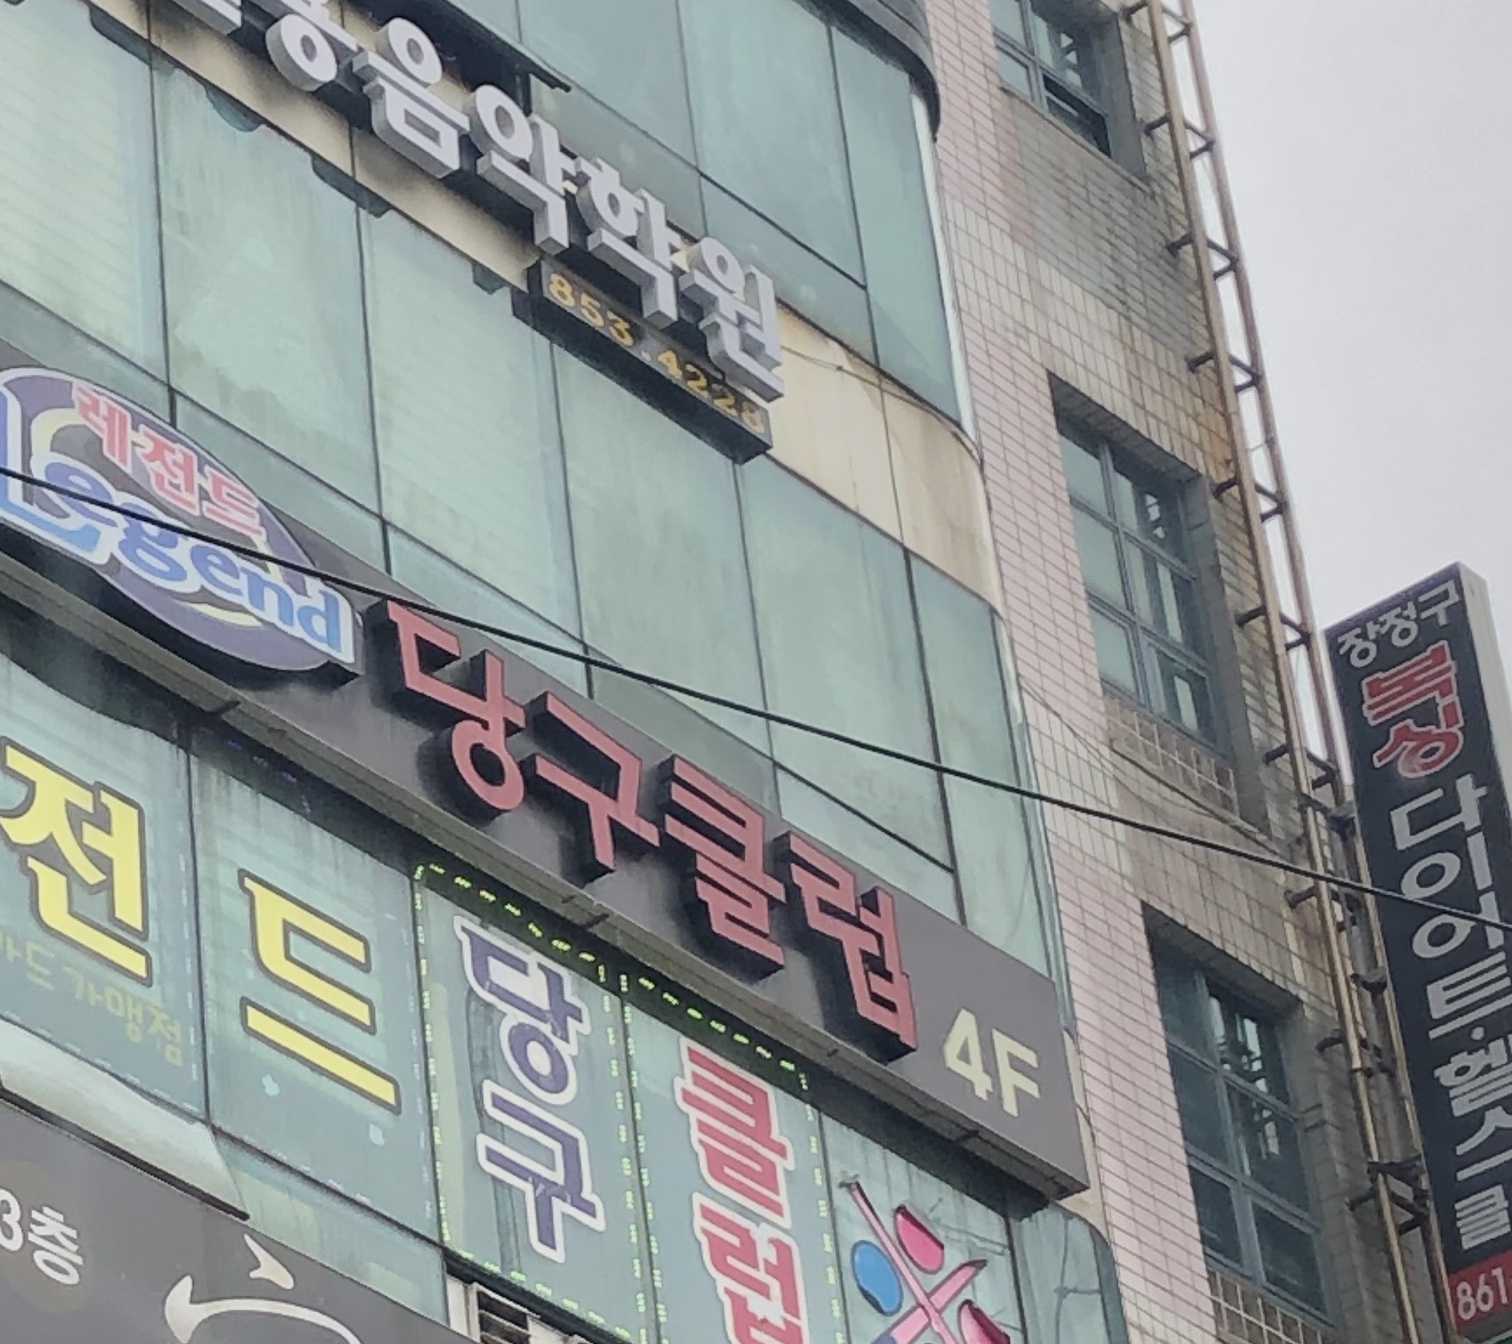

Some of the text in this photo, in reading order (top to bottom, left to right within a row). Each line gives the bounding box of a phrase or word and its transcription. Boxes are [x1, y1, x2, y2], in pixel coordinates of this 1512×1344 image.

[74, 385, 267, 538] 레전드
[1338, 577, 1460, 669] 장정구
[1361, 638, 1465, 779] 복싱
[386, 598, 918, 1053] 당구클럽
[453, 915, 606, 1262] 당구
[940, 1008, 1042, 1118] 4F
